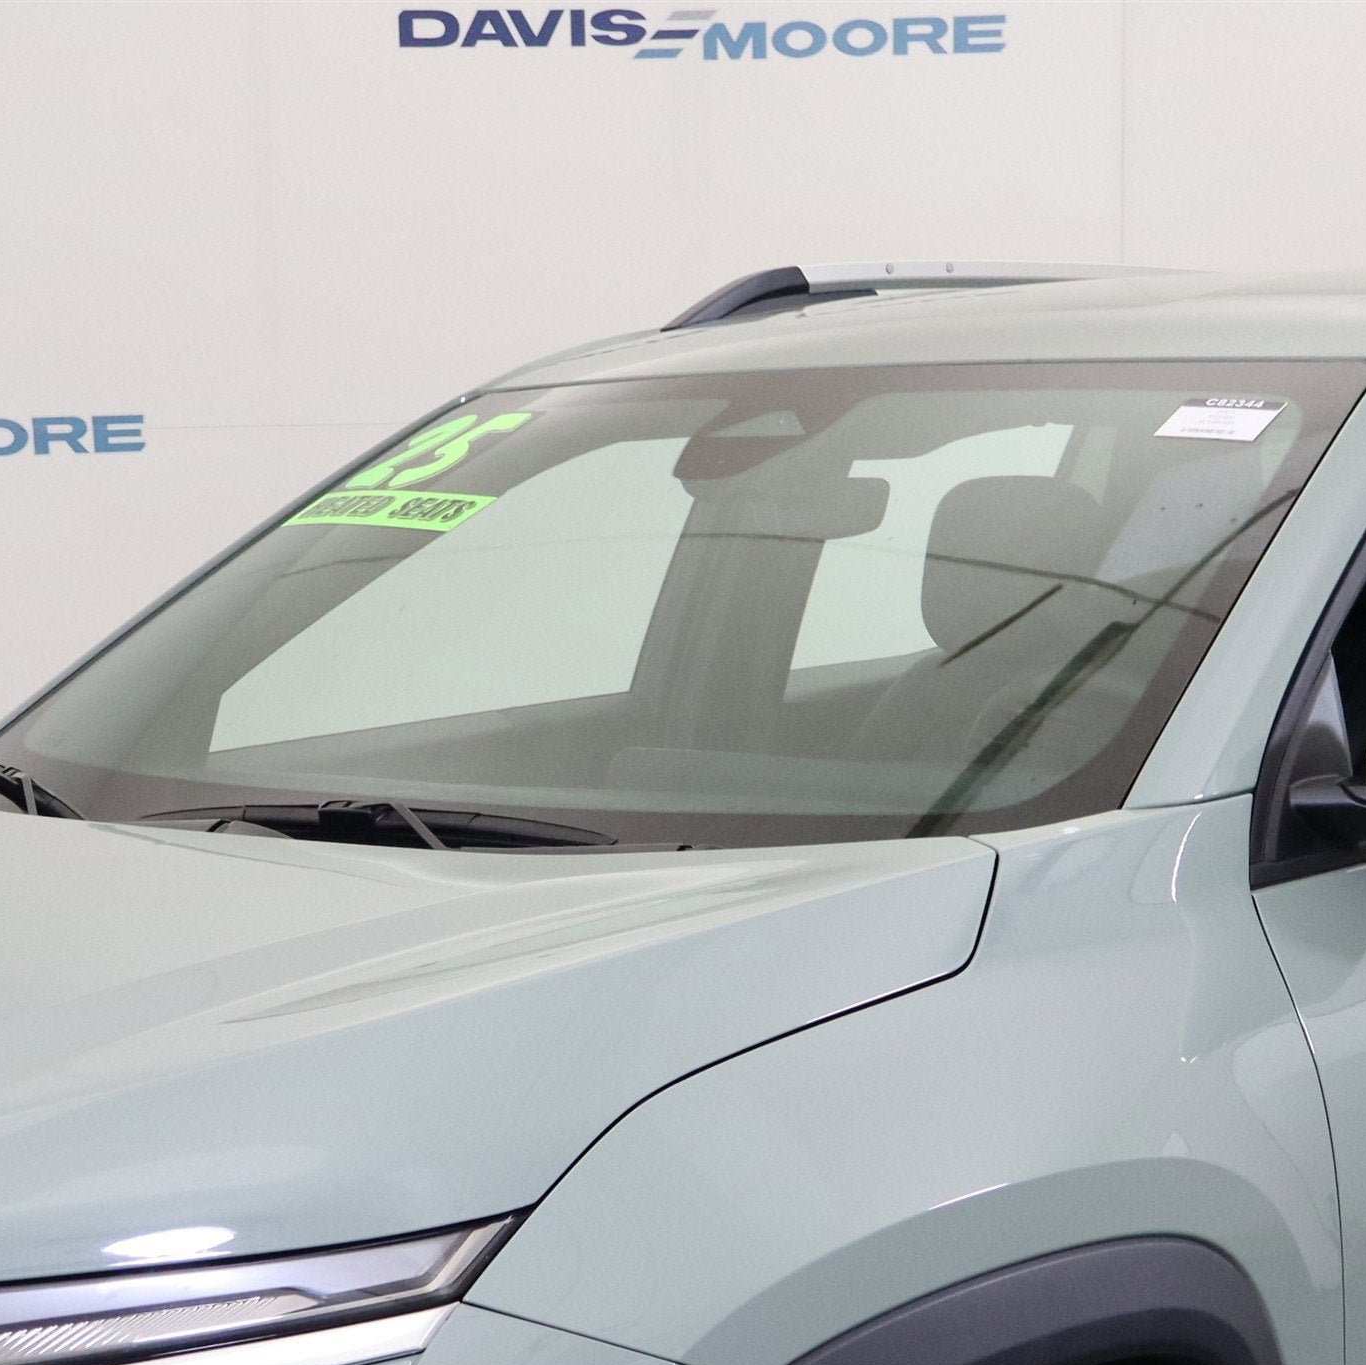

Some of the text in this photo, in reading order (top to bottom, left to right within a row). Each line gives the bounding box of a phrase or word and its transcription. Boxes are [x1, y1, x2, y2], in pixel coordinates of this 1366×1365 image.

[397, 8, 1006, 61] DAVIS MOORE
[344, 411, 532, 490] 25
[387, 496, 477, 523] SEATS
